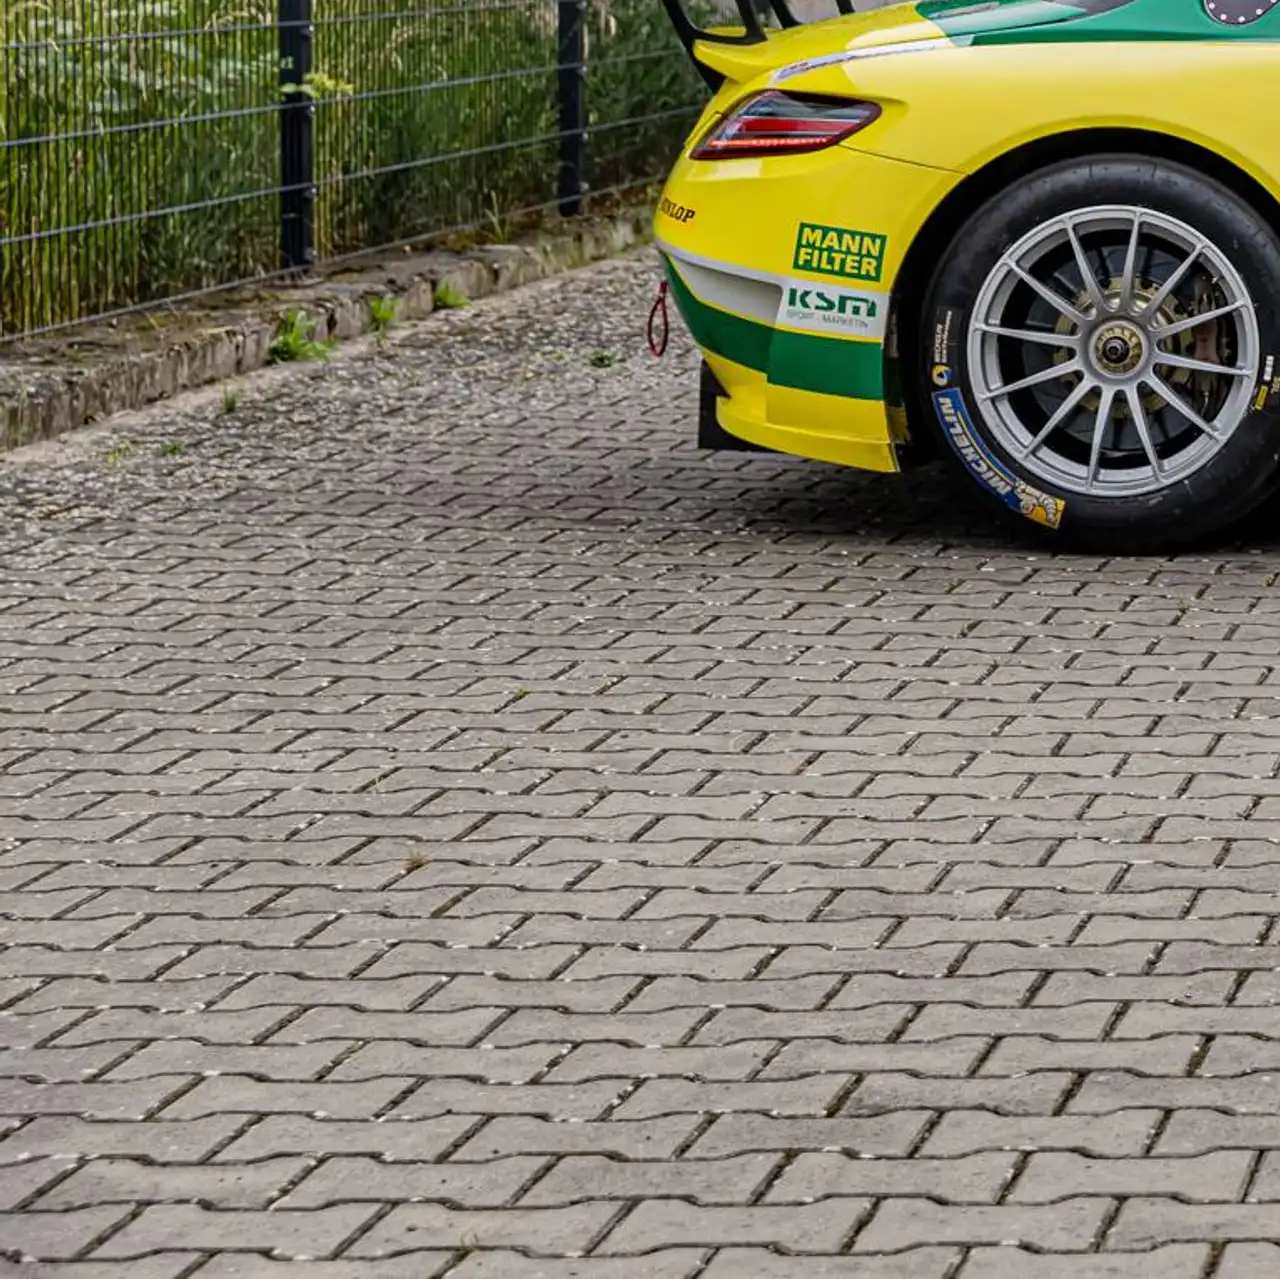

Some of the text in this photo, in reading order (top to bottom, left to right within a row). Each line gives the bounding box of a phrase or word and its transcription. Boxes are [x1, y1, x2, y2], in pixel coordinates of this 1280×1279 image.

[801, 227, 881, 257] MANN
[798, 247, 878, 277] FILTER
[938, 396, 1013, 495] MICHELIN
